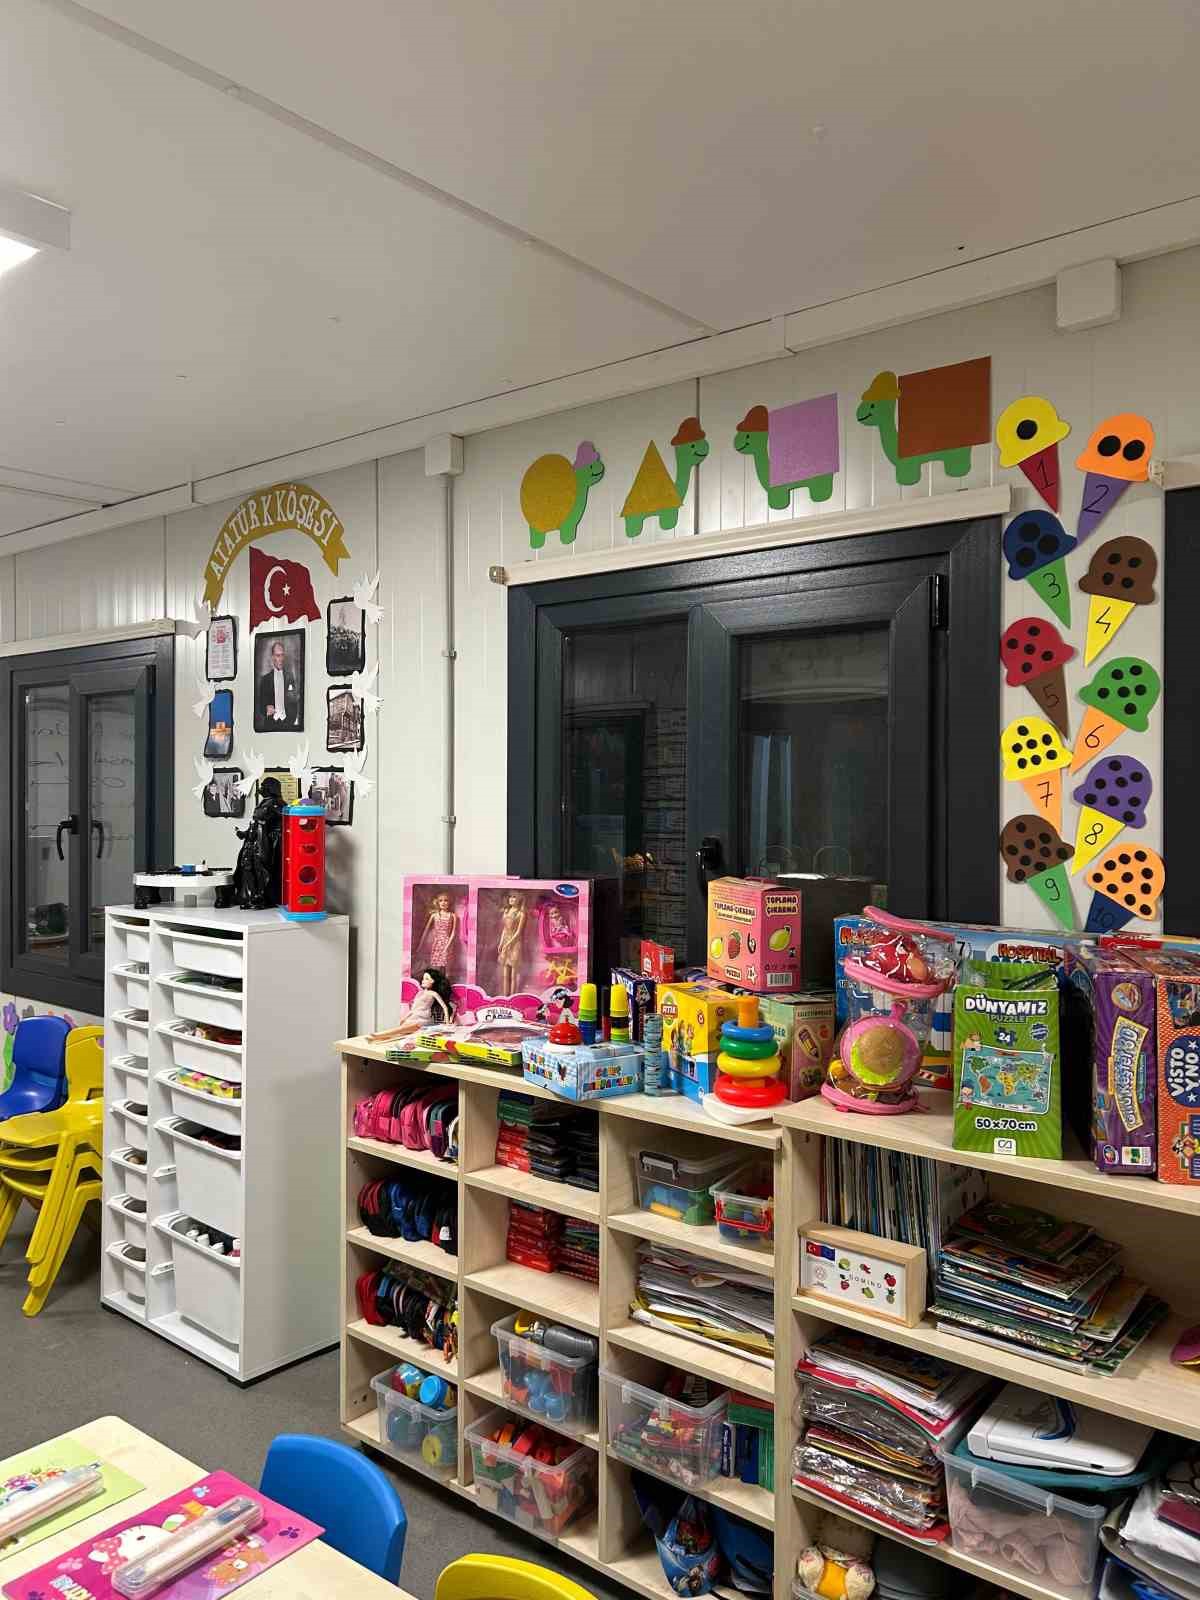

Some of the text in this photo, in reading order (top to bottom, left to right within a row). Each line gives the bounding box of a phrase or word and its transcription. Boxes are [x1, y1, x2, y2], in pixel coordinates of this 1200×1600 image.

[1036, 459, 1056, 490] 1
[1082, 484, 1111, 514] 2
[209, 495, 275, 581] ATATÜRK
[1042, 572, 1062, 599] 3
[1095, 606, 1112, 634] 4
[1042, 683, 1060, 707] 5
[1084, 724, 1105, 749] 6
[1036, 781, 1053, 809] 7
[1084, 822, 1104, 846] 8
[1044, 878, 1061, 902] 9
[1091, 906, 1116, 929] 10
[965, 994, 1048, 1016] DÜNYAMIZ
[991, 1015, 1026, 1023] PUZZLE
[998, 1032, 1011, 1042] 24
